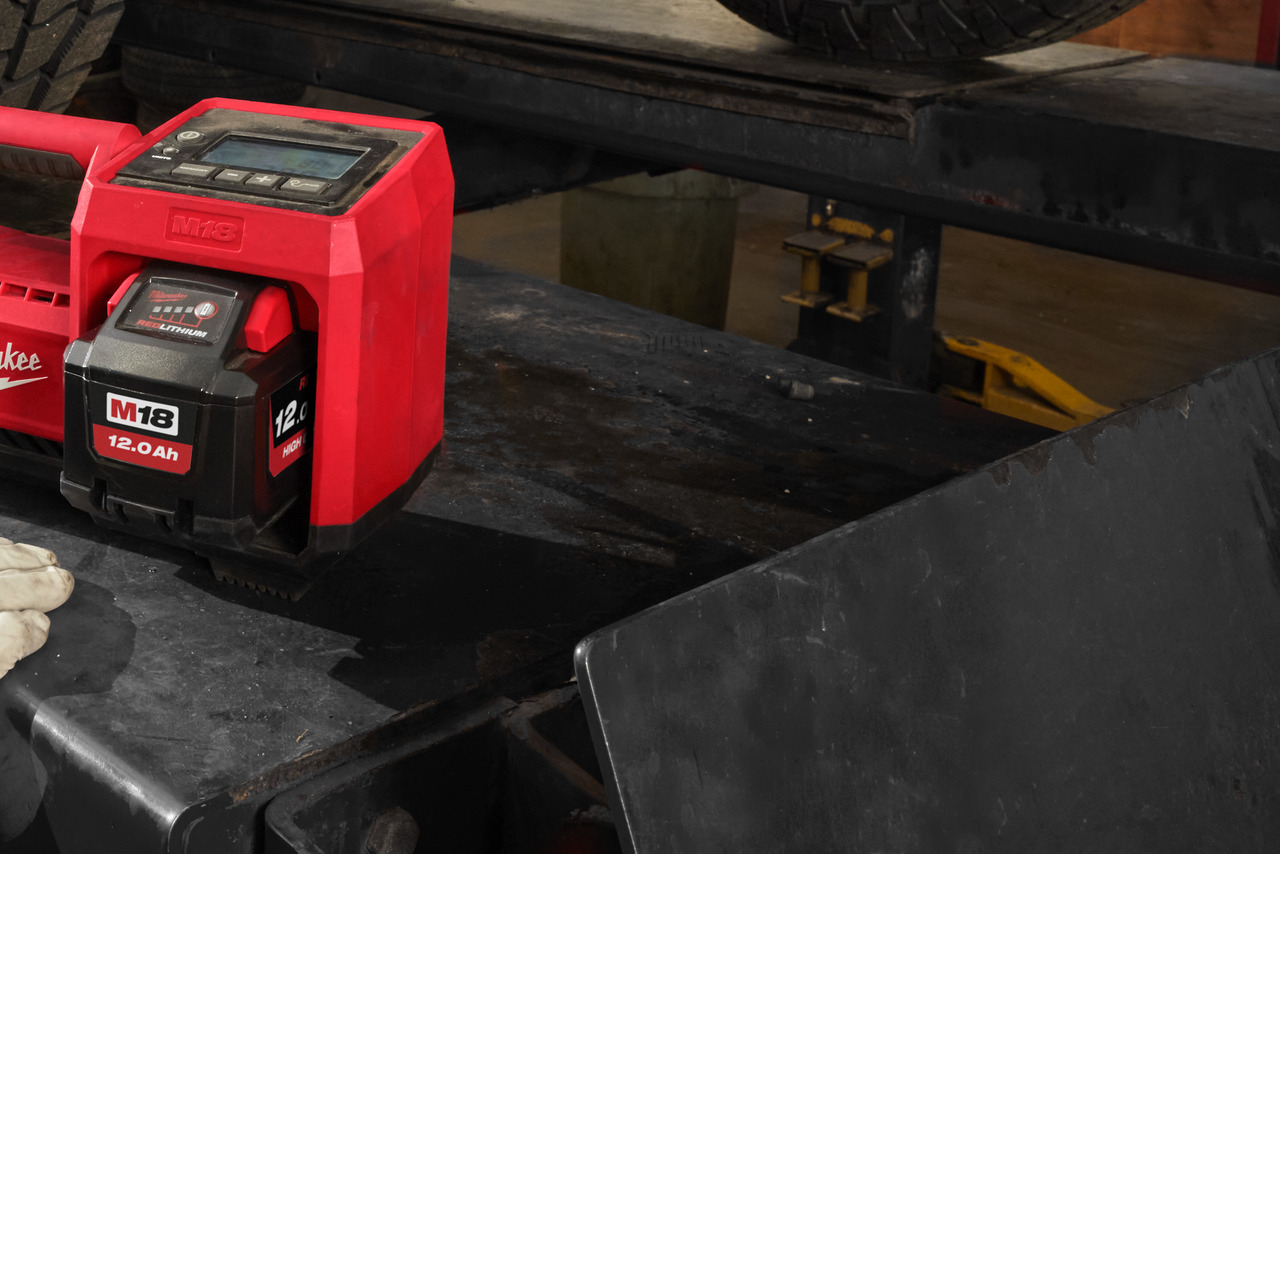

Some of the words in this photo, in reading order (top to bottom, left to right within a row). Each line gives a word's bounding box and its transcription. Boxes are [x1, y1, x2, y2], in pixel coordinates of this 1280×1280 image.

[171, 215, 239, 243] M18
[136, 319, 208, 338] REDLITHIUM
[110, 397, 175, 430] M18
[282, 435, 302, 459] HIGH
